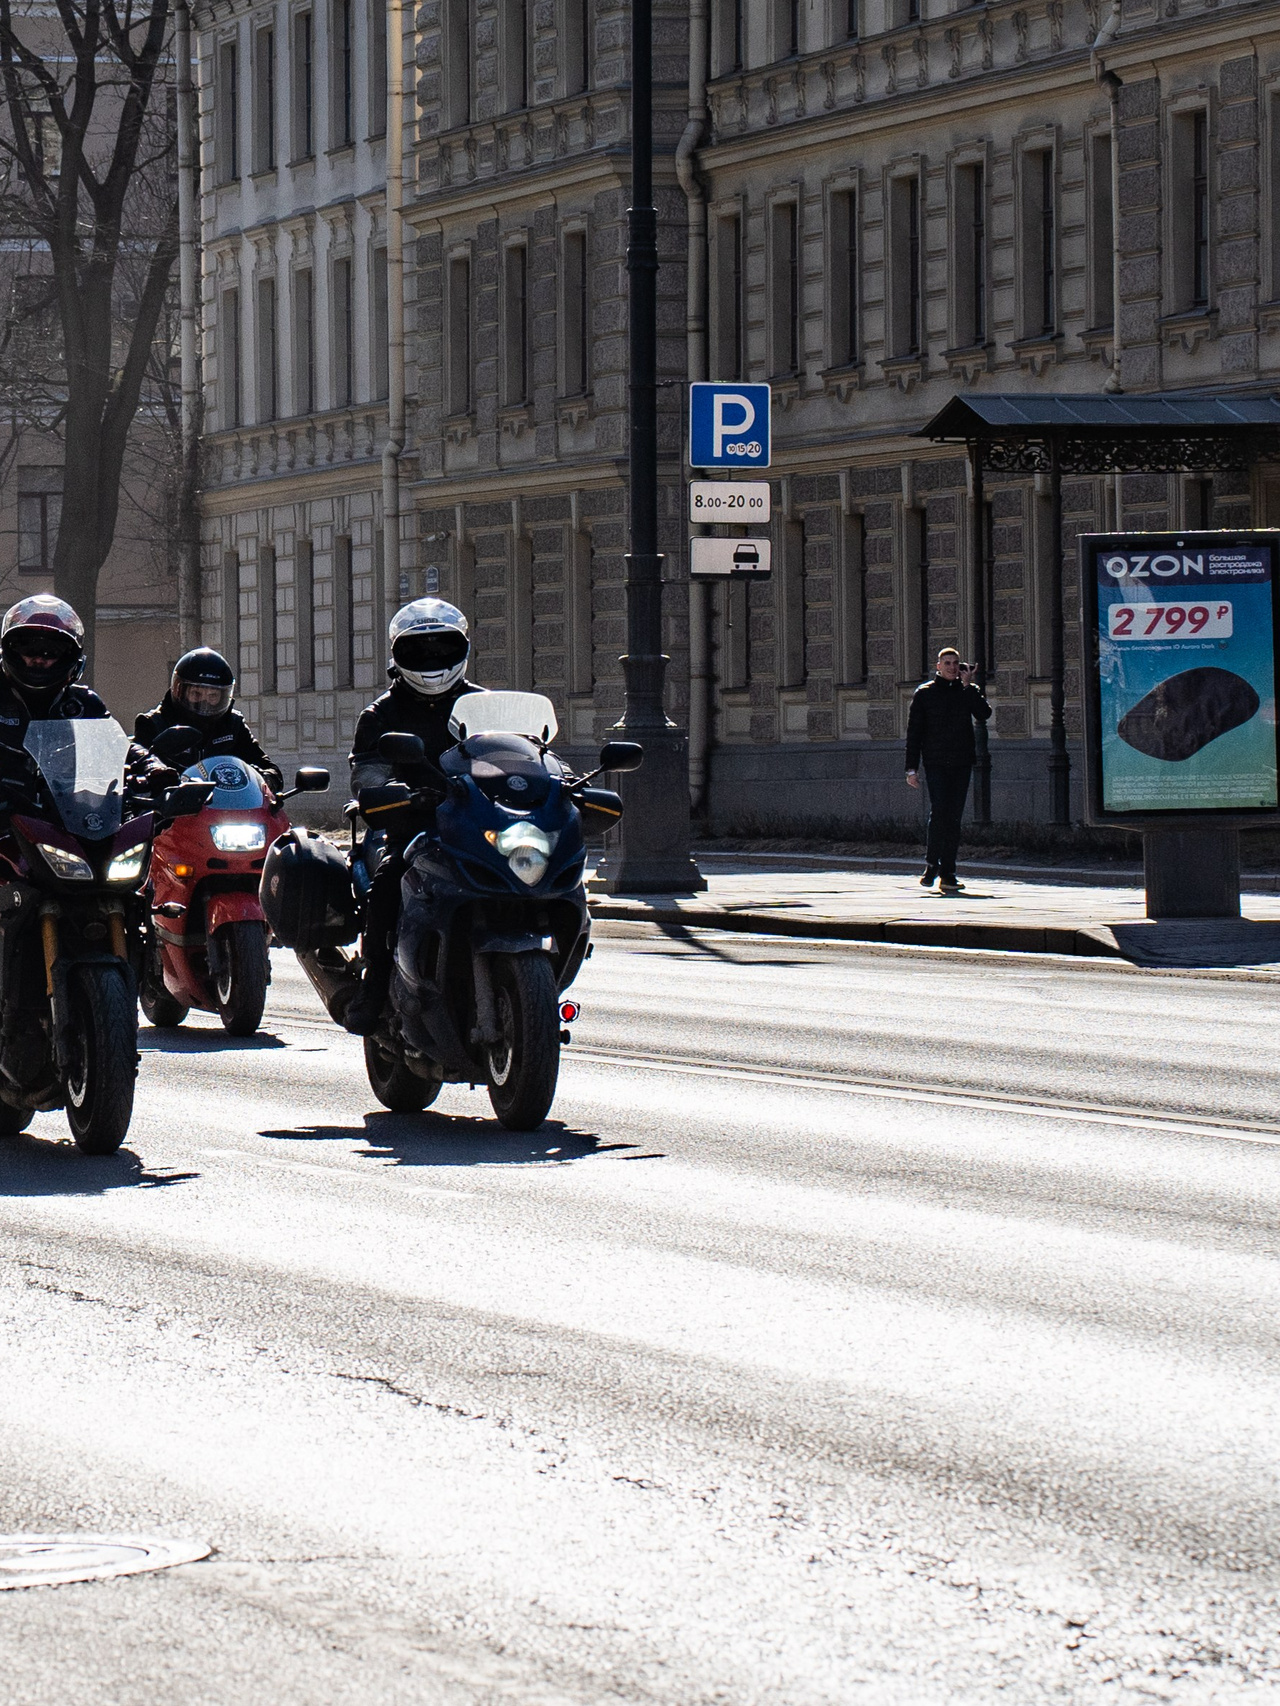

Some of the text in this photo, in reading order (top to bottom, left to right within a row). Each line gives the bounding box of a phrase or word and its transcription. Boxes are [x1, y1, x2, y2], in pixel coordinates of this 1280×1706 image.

[713, 393, 756, 458] P
[737, 444, 746, 453] 15
[748, 443, 761, 454] 20
[1106, 554, 1204, 578] OZON
[1208, 554, 1247, 562] большая
[1208, 561, 1263, 569] распродажа
[1143, 605, 1210, 636] 799
